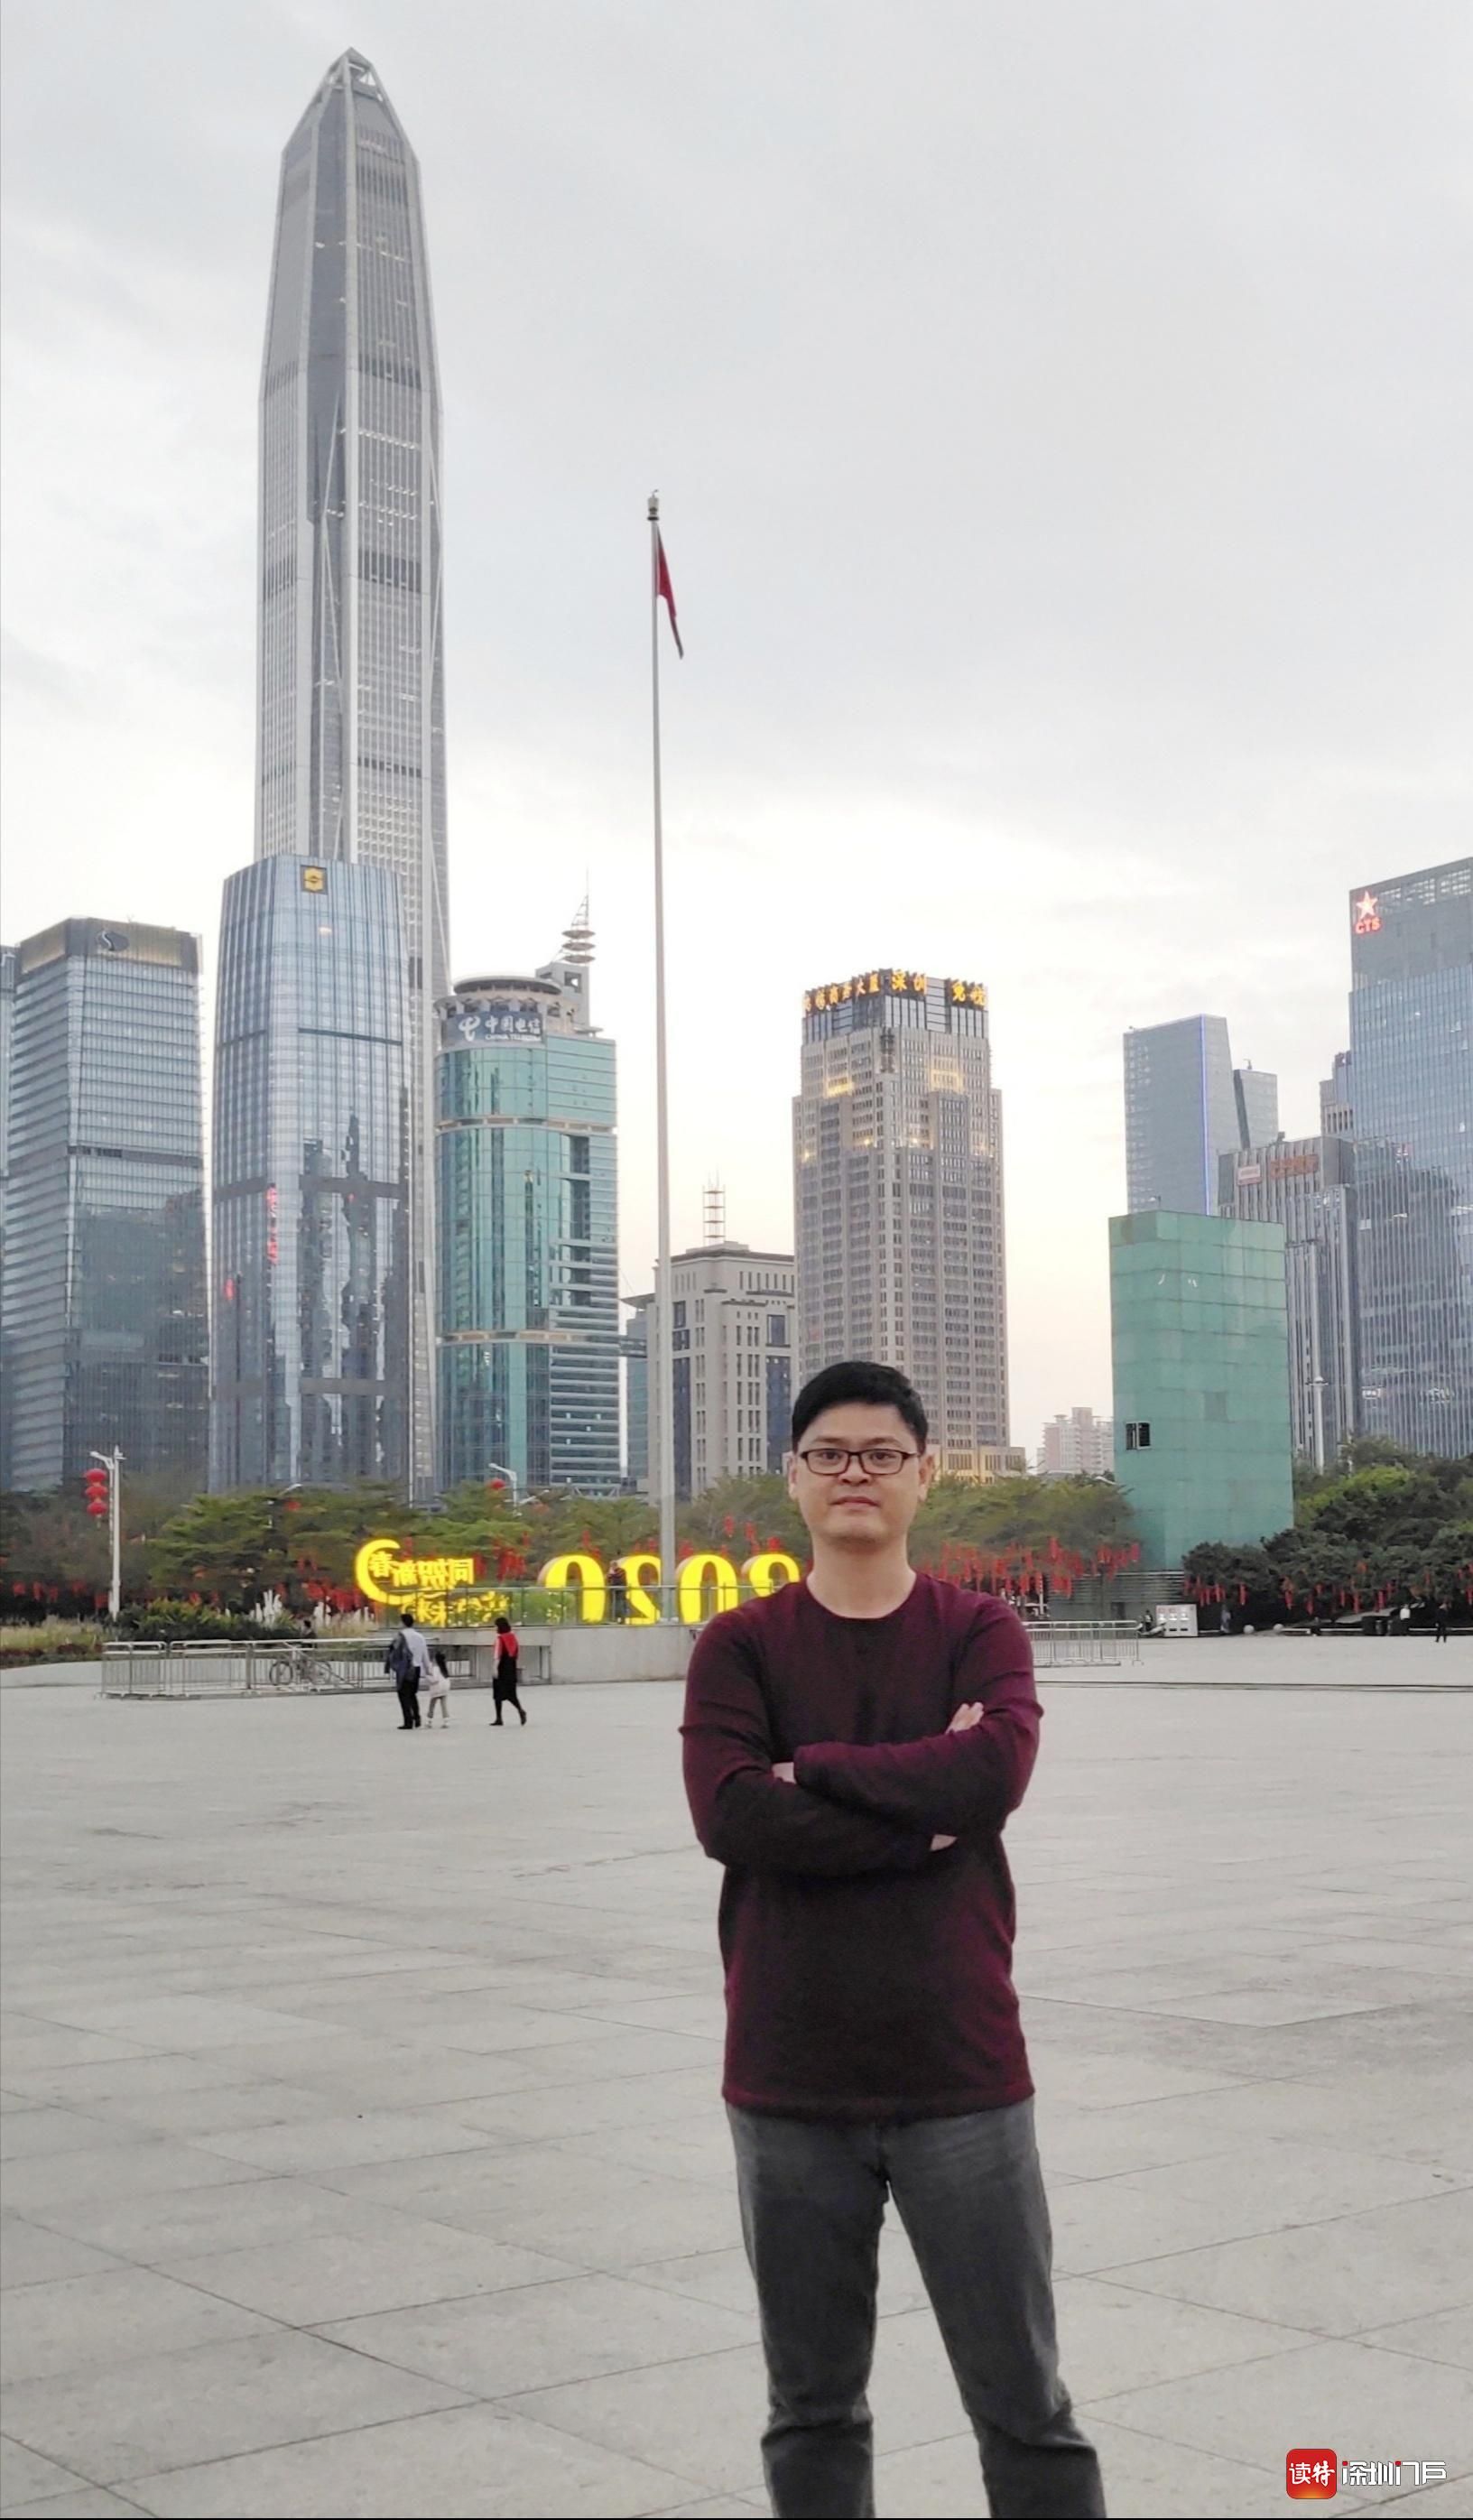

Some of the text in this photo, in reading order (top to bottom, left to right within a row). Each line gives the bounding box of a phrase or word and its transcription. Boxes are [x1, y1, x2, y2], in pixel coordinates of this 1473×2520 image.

[1356, 917, 1381, 934] CTS
[485, 1015, 541, 1033] 中国电信
